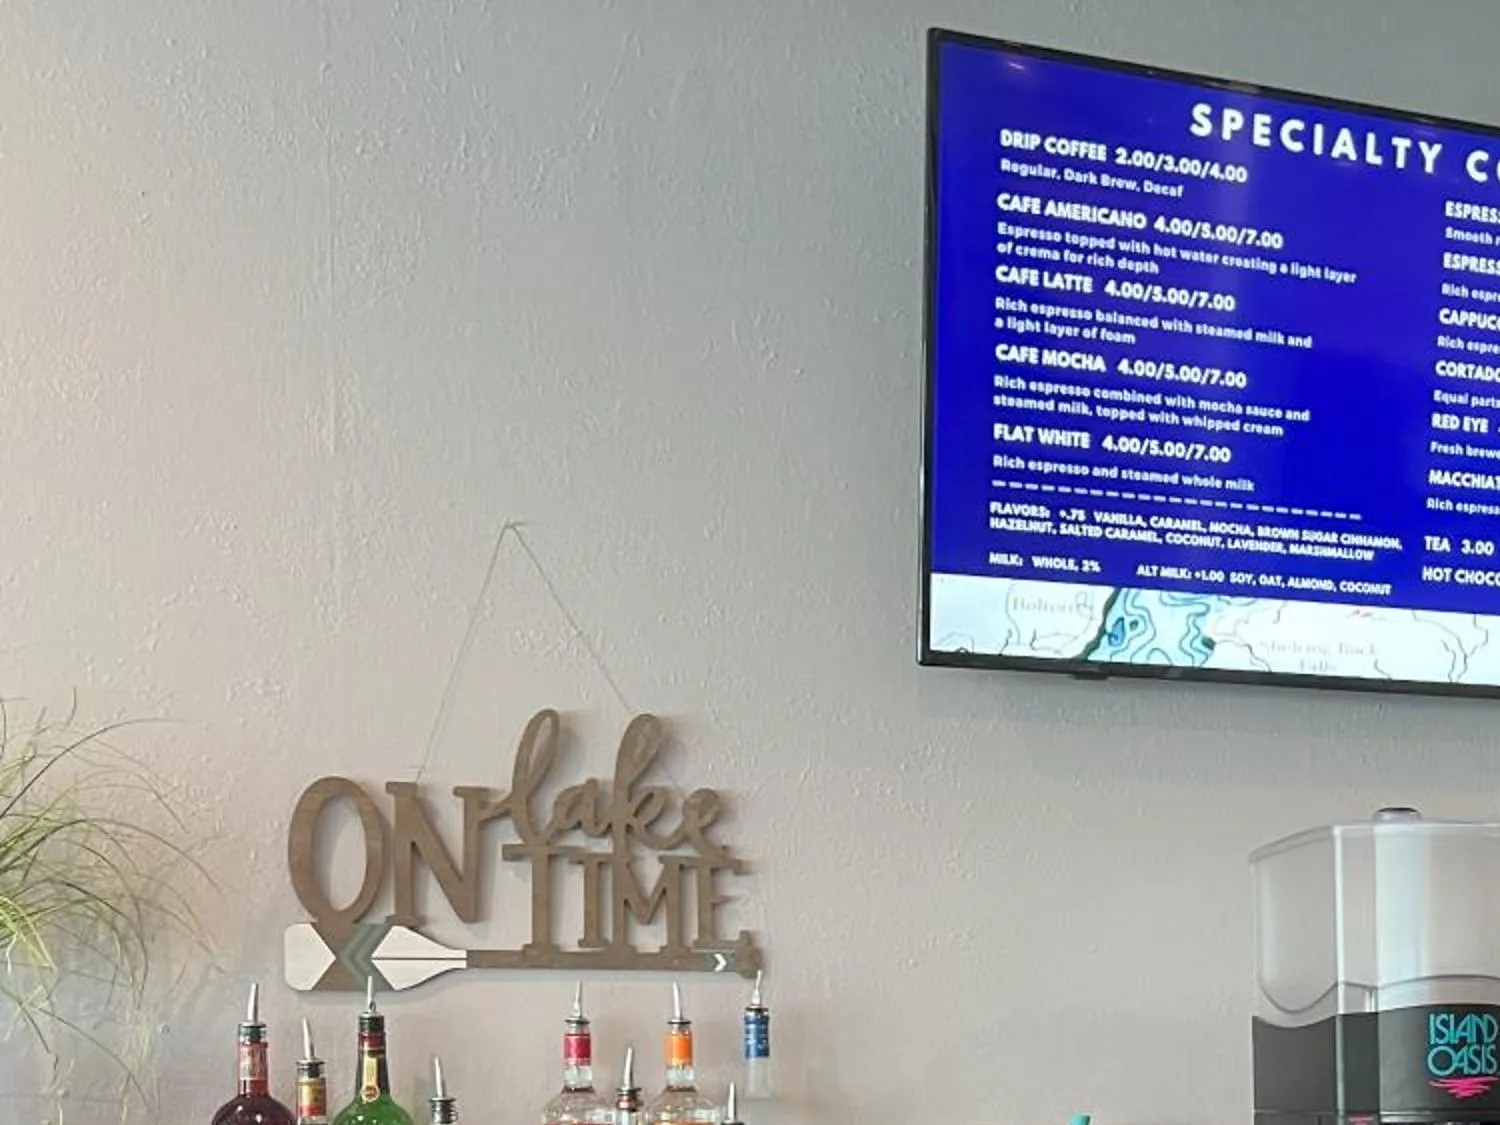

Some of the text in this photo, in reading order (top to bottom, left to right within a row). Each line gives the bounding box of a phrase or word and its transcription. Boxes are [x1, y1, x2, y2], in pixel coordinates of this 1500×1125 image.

[1001, 129, 1248, 183] DRIP COFFEE 2.00/3.00/4.00
[1190, 104, 1442, 174] SPECIALTY
[1064, 168, 1098, 185] Dark
[1144, 180, 1184, 197] Decaf
[997, 193, 1283, 249] CAFE AMERICANO 4.00/5.00/7.00
[997, 242, 1159, 274] of crema for rich depth
[998, 222, 1357, 284] Espresso topped with hot water creating a light layer
[996, 265, 1236, 312] CAFE LATTE 4.00/5.00/7.00
[995, 317, 1136, 344] a light layer of foam
[996, 344, 1247, 389] CAFE MOCHA 4.00/5.00/7.00
[994, 395, 1055, 411] steamed
[1096, 406, 1145, 421] topped
[1148, 411, 1180, 425] with
[1182, 416, 1241, 432] whipped
[1243, 423, 1284, 436] cream
[1432, 413, 1460, 430] RED
[1463, 416, 1489, 433] EYE
[994, 423, 1231, 463] FLAT WHITE 4.00/5.00/7.00
[994, 455, 1254, 491] Rich espresso and steamed whole milk
[1425, 536, 1494, 556] TEA 3.00
[1423, 566, 1453, 582] HOT
[490, 708, 723, 853] lake
[288, 775, 495, 926] ON
[502, 843, 755, 950] TIME
[1428, 1012, 1499, 1046] ISLAND
[1427, 1045, 1499, 1077] OASIS
